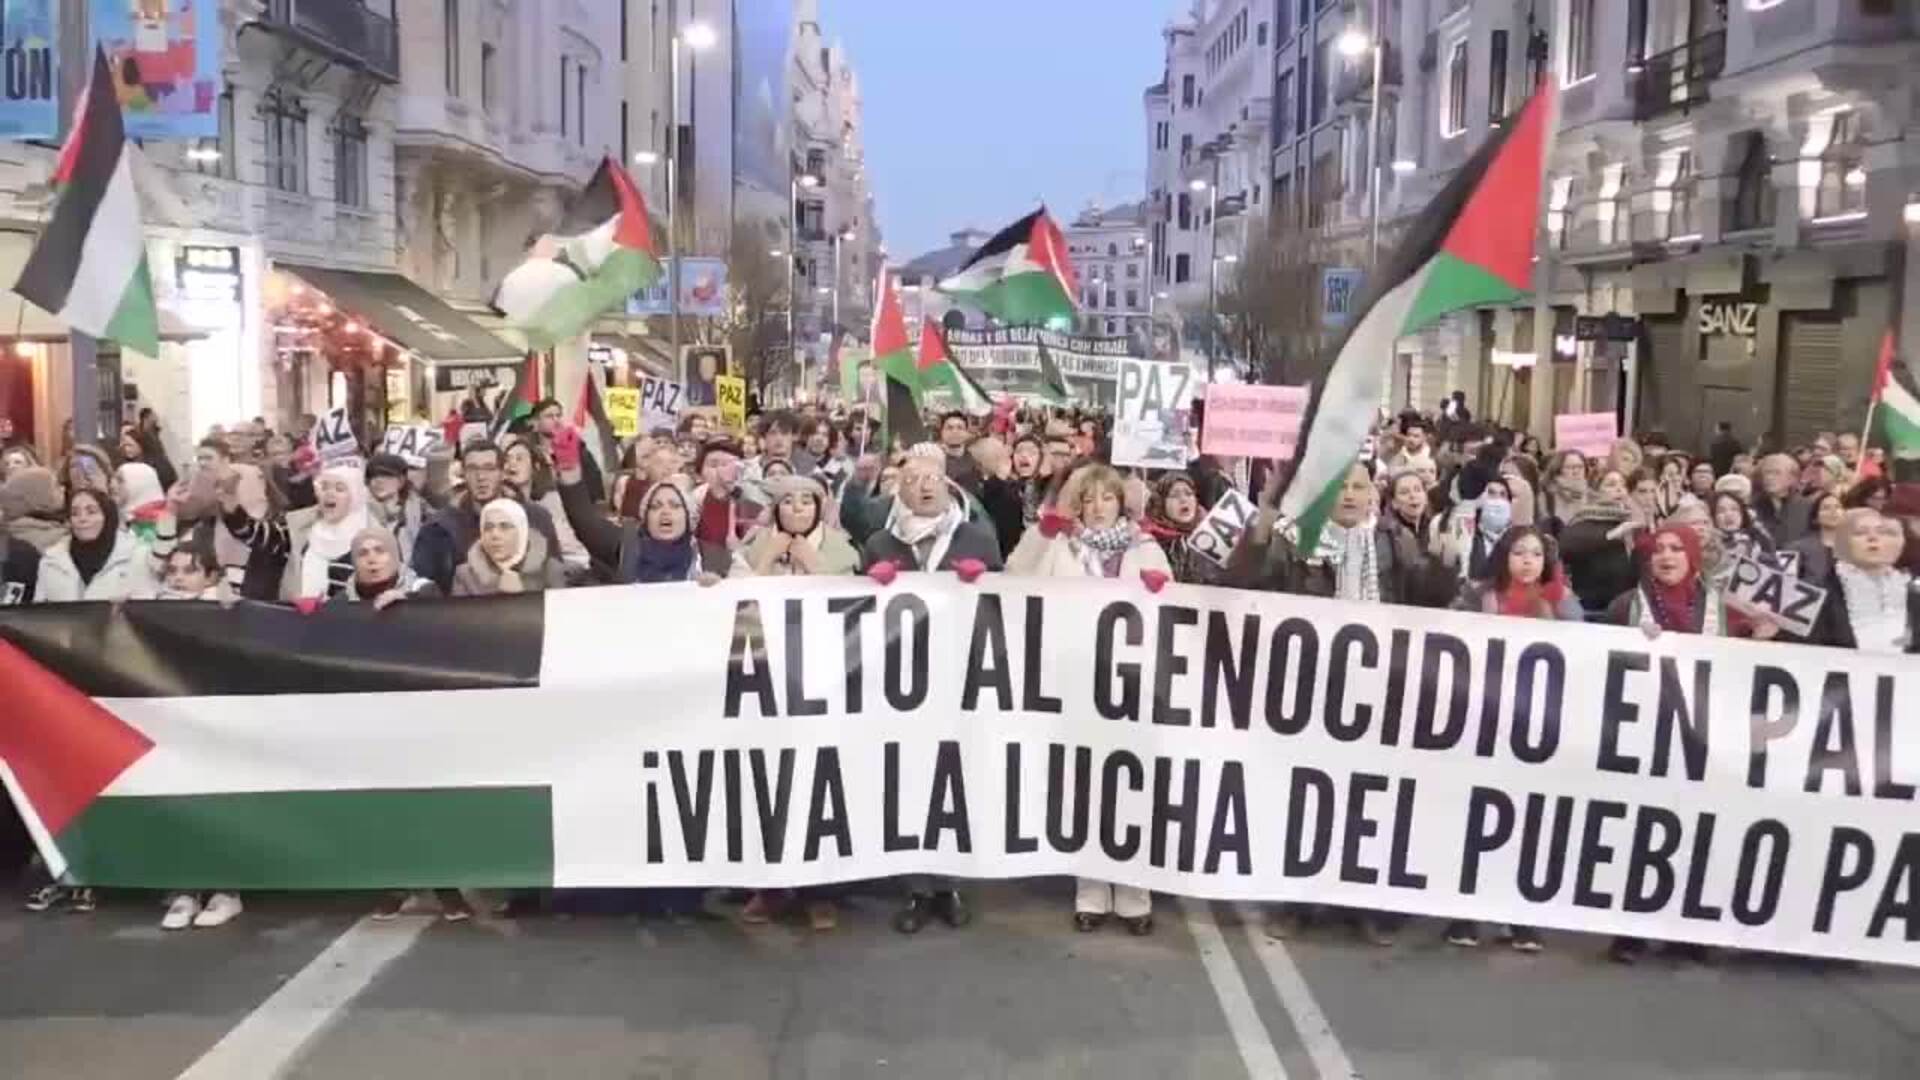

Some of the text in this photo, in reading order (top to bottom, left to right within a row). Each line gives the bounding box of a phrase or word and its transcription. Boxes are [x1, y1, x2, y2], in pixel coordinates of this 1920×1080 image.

[1699, 304, 1756, 333] SANZ
[642, 379, 680, 415] PAZ
[720, 383, 742, 405] PAZ
[1118, 361, 1190, 421] PAZ
[385, 426, 441, 457] PAZ
[1195, 493, 1247, 561] PAZ
[1728, 557, 1821, 625] PAZ
[724, 593, 1916, 800] ALTO AL GENOCIDIO EN PAL
[642, 740, 1920, 943] ¡VIVA LA LUCHA DEL PUEBLO PA
